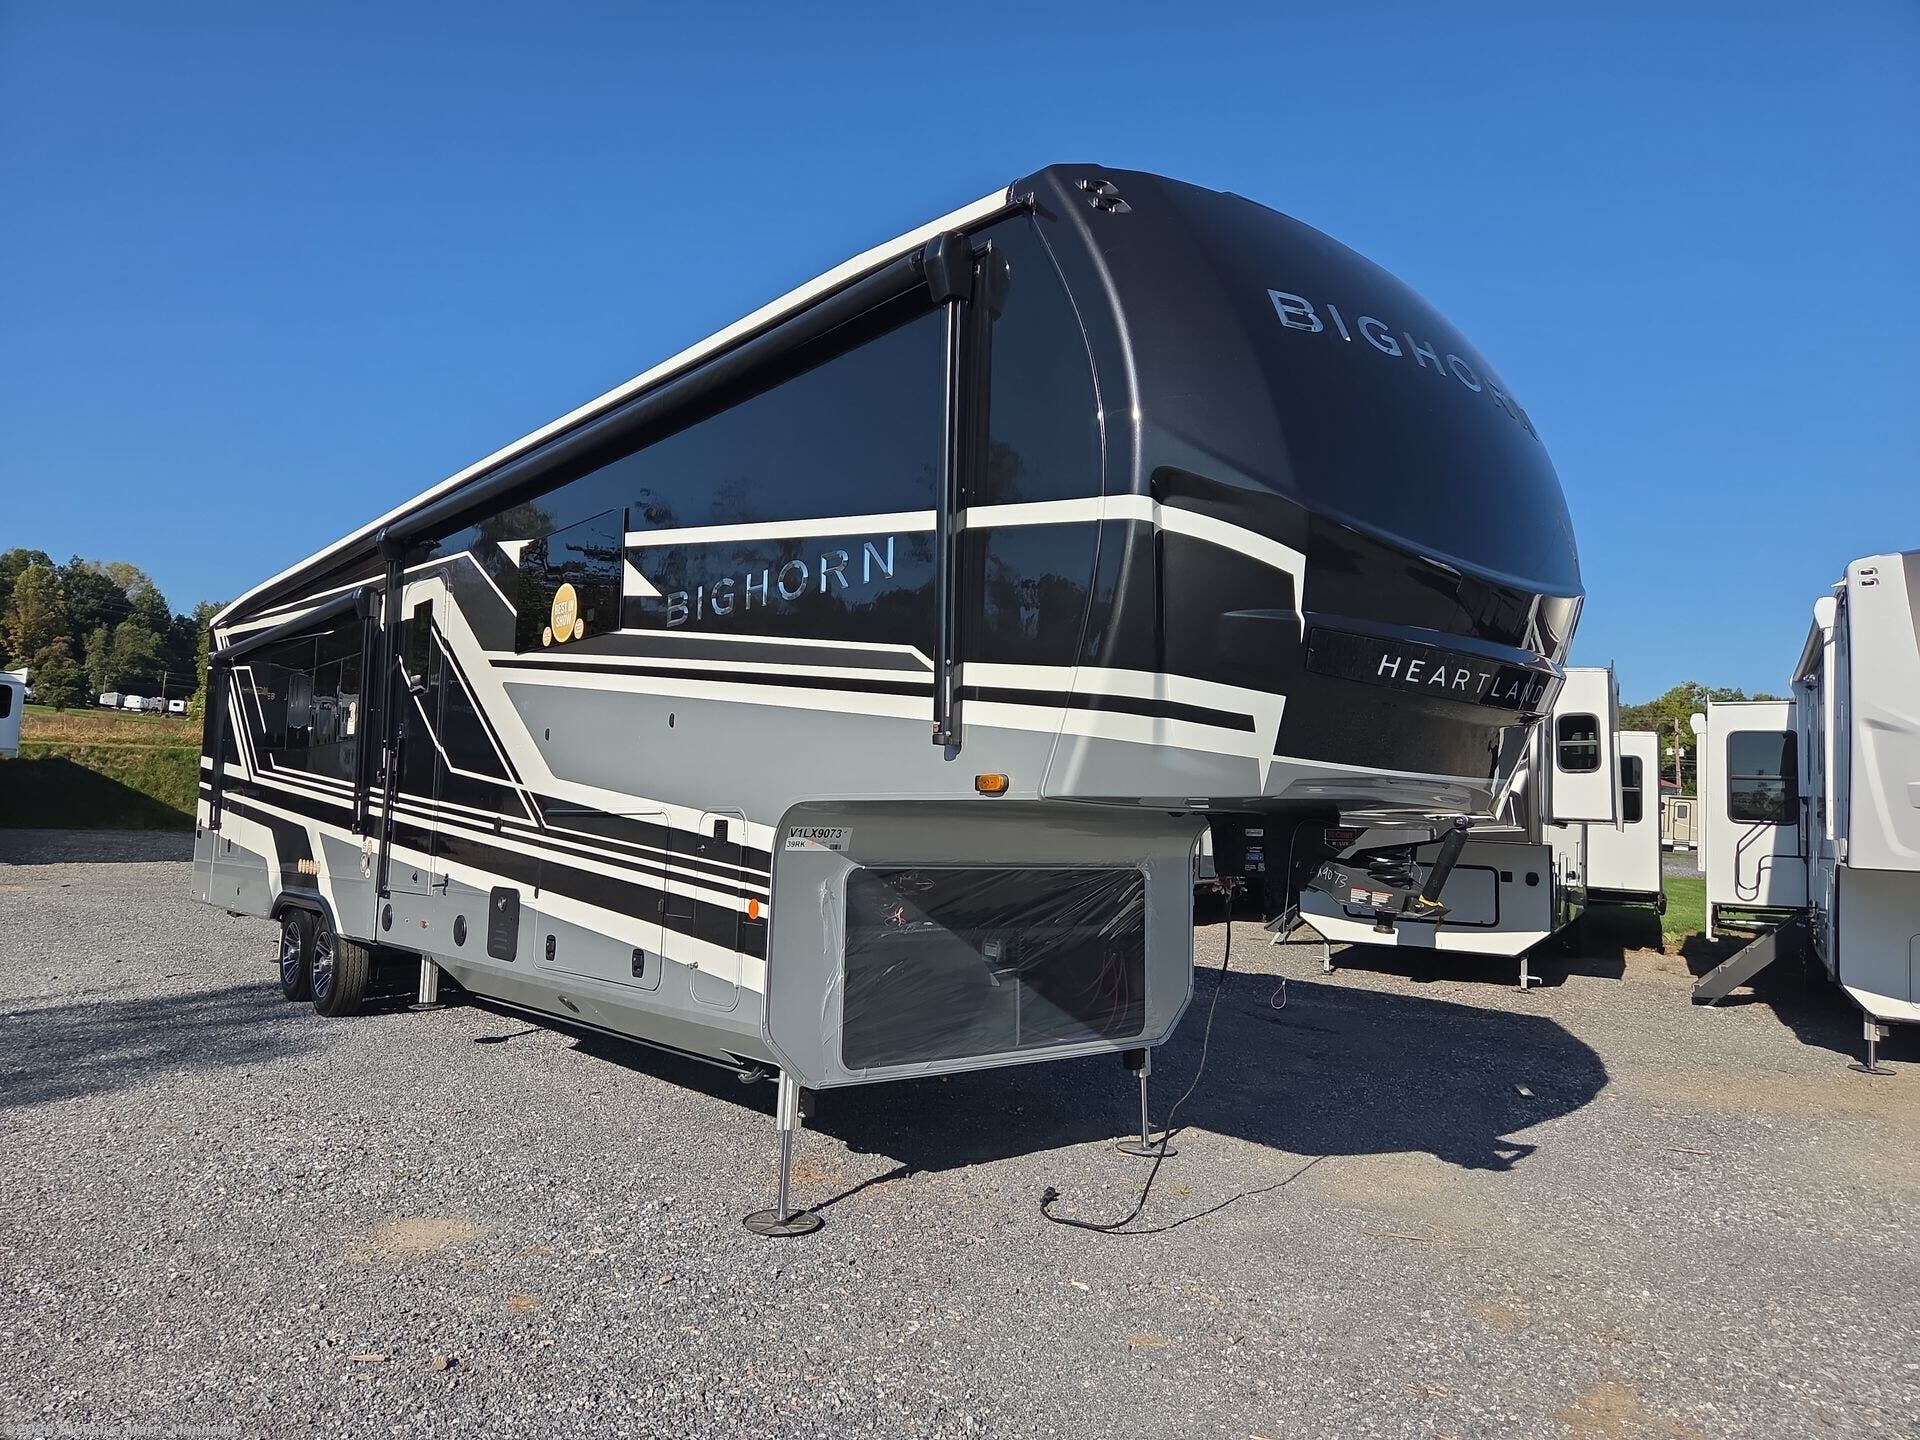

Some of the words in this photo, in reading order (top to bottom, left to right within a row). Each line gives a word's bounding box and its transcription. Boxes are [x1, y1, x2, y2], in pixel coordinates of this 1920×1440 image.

[1266, 288, 1540, 442] BIGHORN
[666, 536, 894, 628] BIGHORN
[1377, 654, 1544, 704] HEARTLAND
[787, 840, 806, 848] 39RK
[790, 827, 843, 838] V1LX9073
